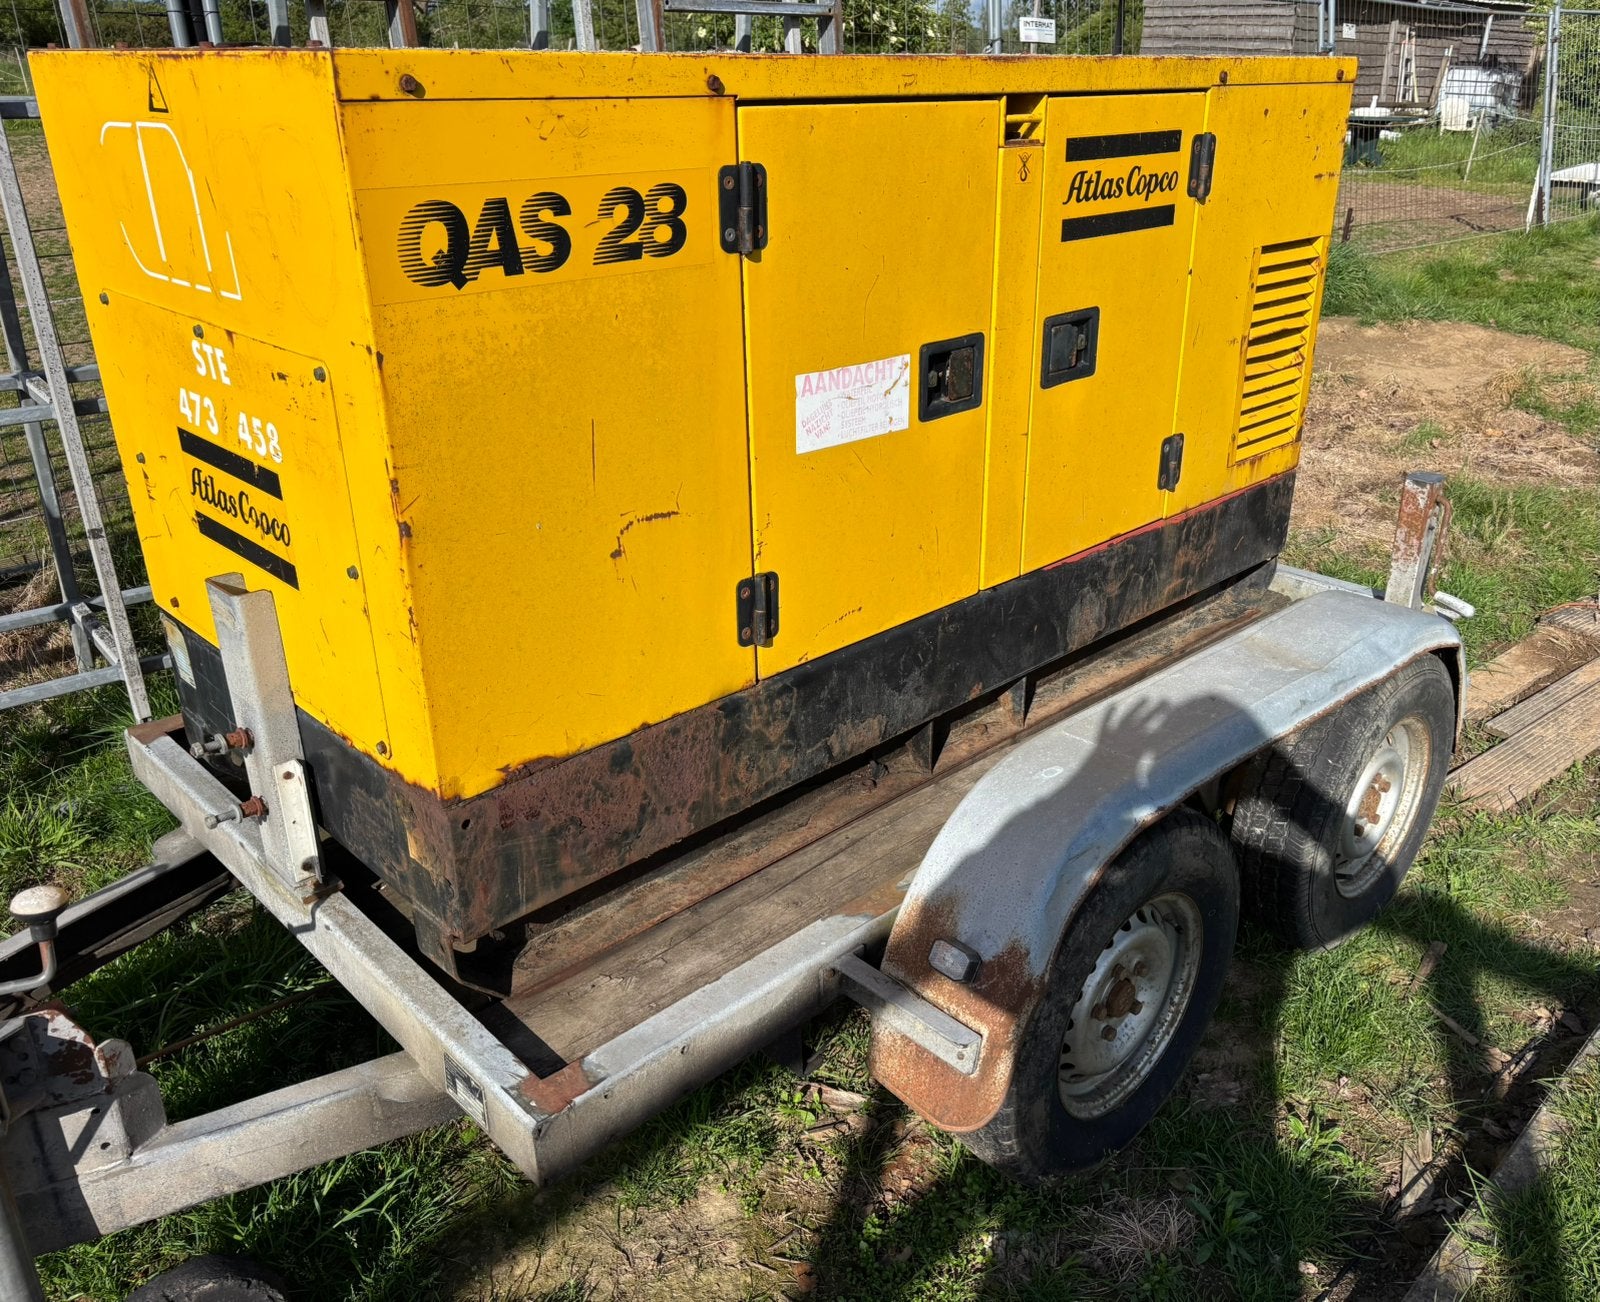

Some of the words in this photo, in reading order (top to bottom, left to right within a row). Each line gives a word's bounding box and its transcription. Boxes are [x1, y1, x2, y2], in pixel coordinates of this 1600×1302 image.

[1023, 20, 1053, 29] INTERMAT
[1062, 169, 1125, 206] Atlas
[1126, 165, 1179, 202] Copco
[397, 190, 573, 291] QAS
[592, 182, 688, 267] 28
[191, 339, 232, 386] STE
[179, 387, 219, 435] 473
[237, 411, 283, 464] 458
[190, 467, 238, 519] Atlas
